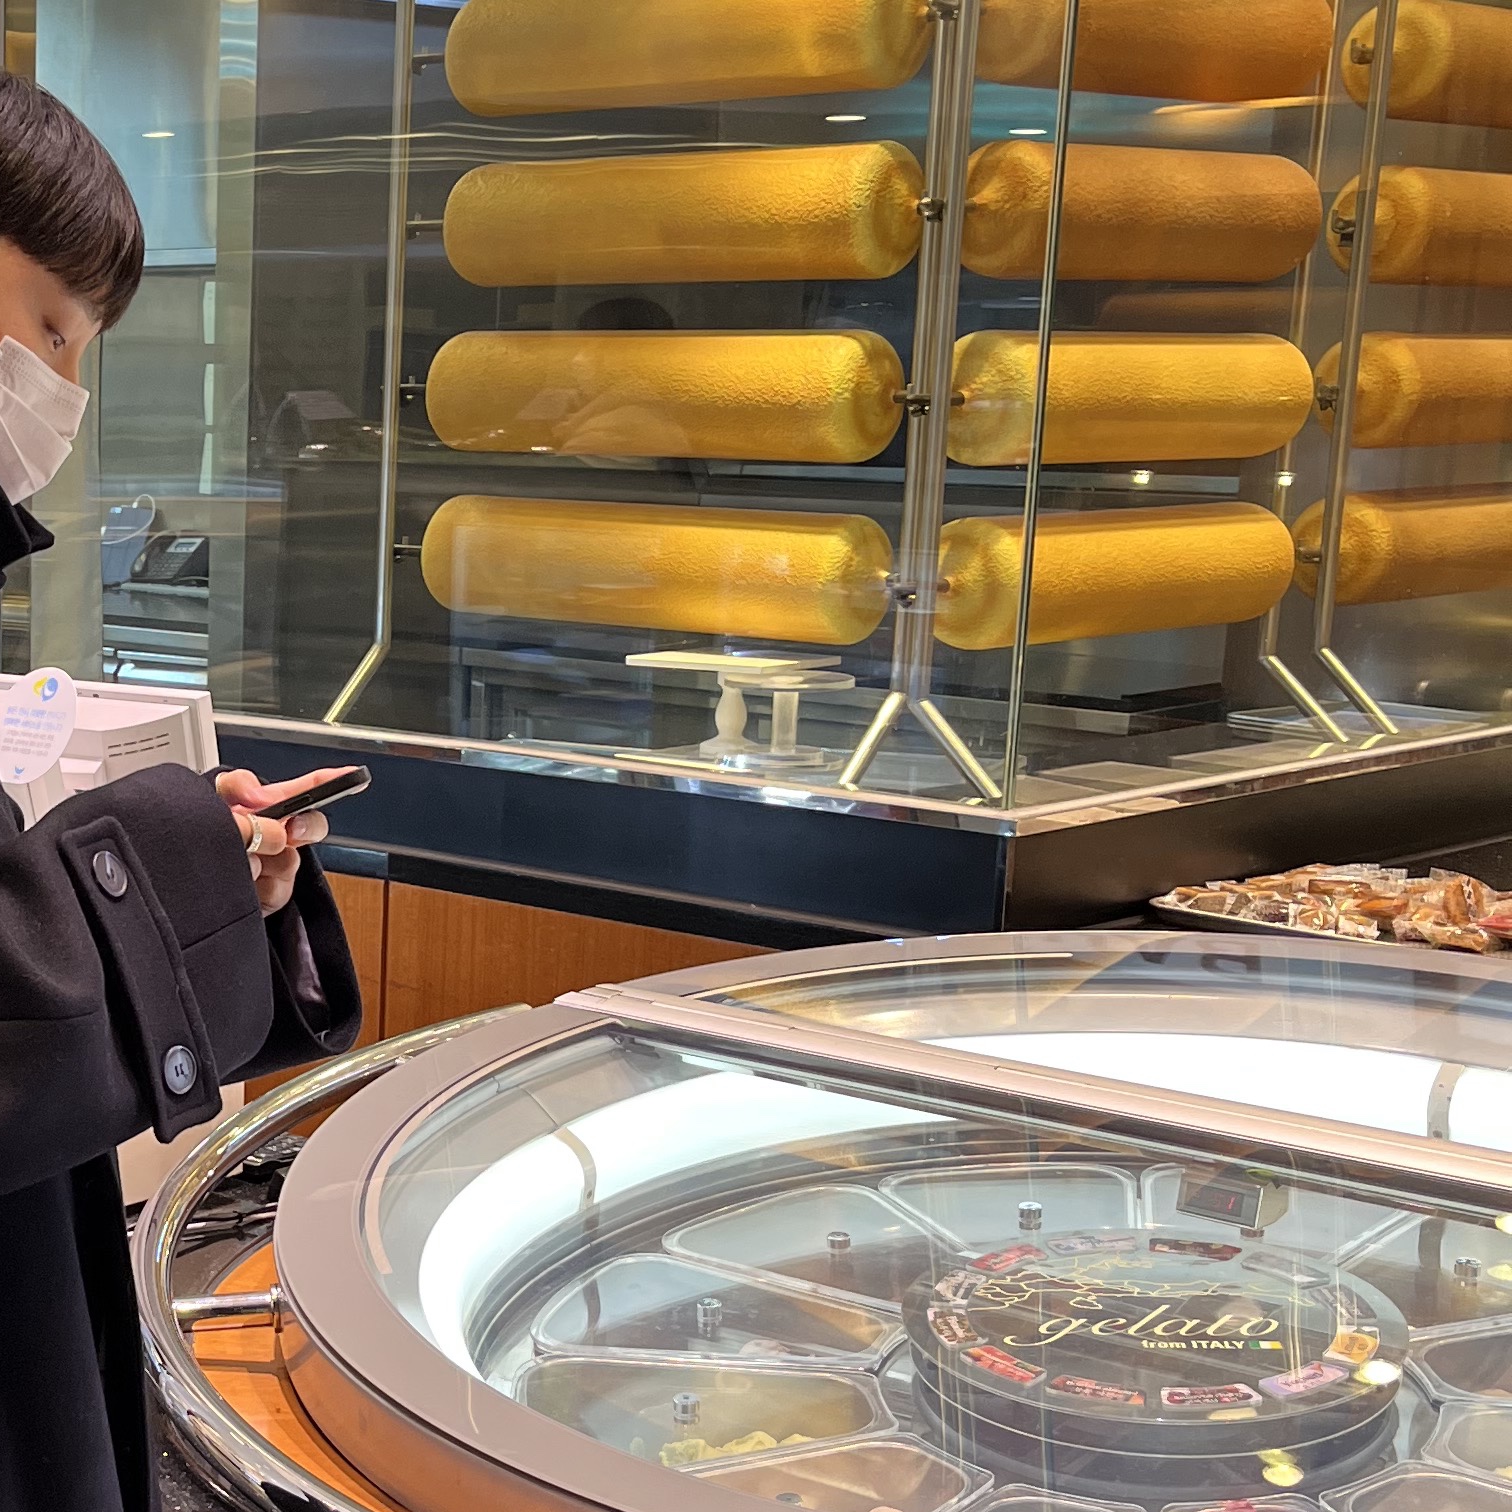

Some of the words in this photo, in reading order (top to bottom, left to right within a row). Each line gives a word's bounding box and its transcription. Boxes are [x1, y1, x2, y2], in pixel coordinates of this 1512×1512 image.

[1003, 1304, 1280, 1347] gelato
[1141, 1339, 1187, 1349] from
[1190, 1340, 1245, 1349] ITALY
